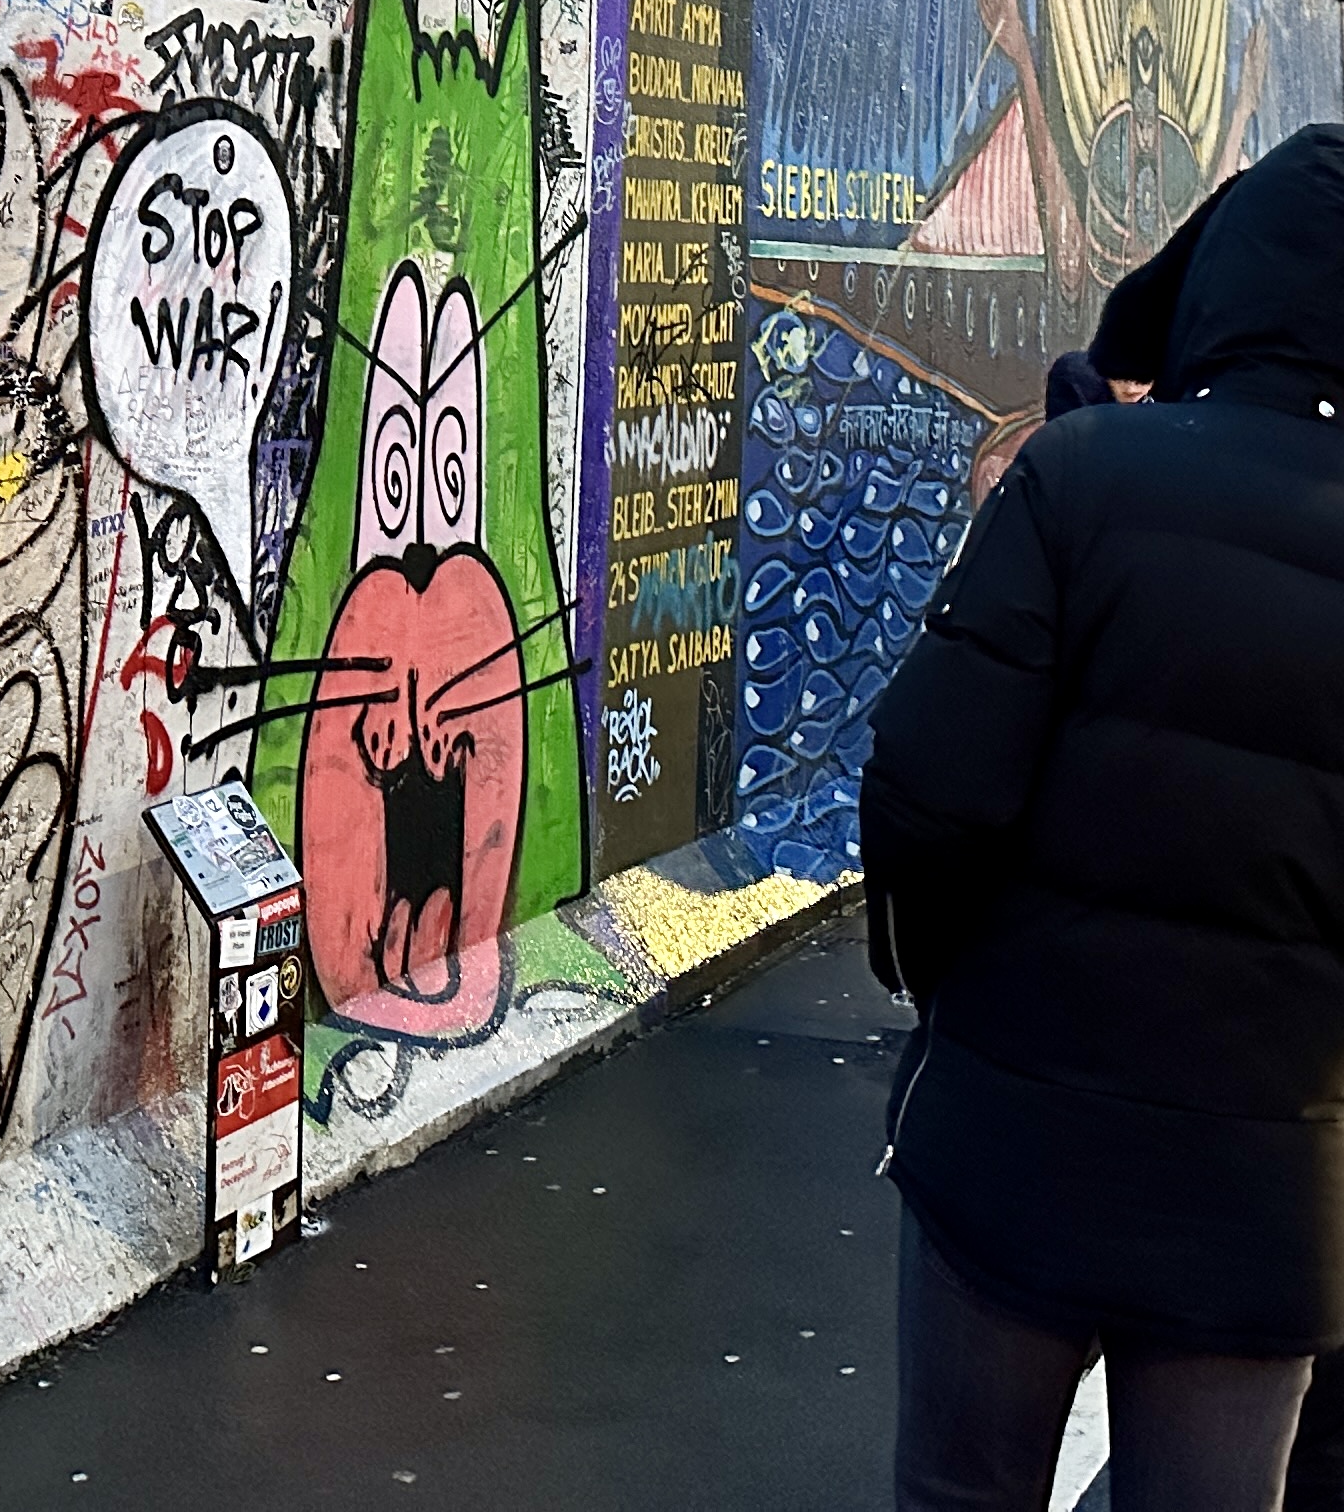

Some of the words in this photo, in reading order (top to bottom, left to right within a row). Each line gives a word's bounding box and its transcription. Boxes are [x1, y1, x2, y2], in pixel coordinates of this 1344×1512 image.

[680, 2, 722, 48] AMMA
[761, 160, 839, 221] SIEBEN
[138, 173, 262, 286] STOP
[91, 512, 126, 538] RTXX
[666, 482, 703, 530] STEH
[715, 478, 739, 519] MIN
[608, 646, 660, 688] SATYA
[667, 624, 733, 676] SAIBABA
[260, 920, 299, 952] FROST
